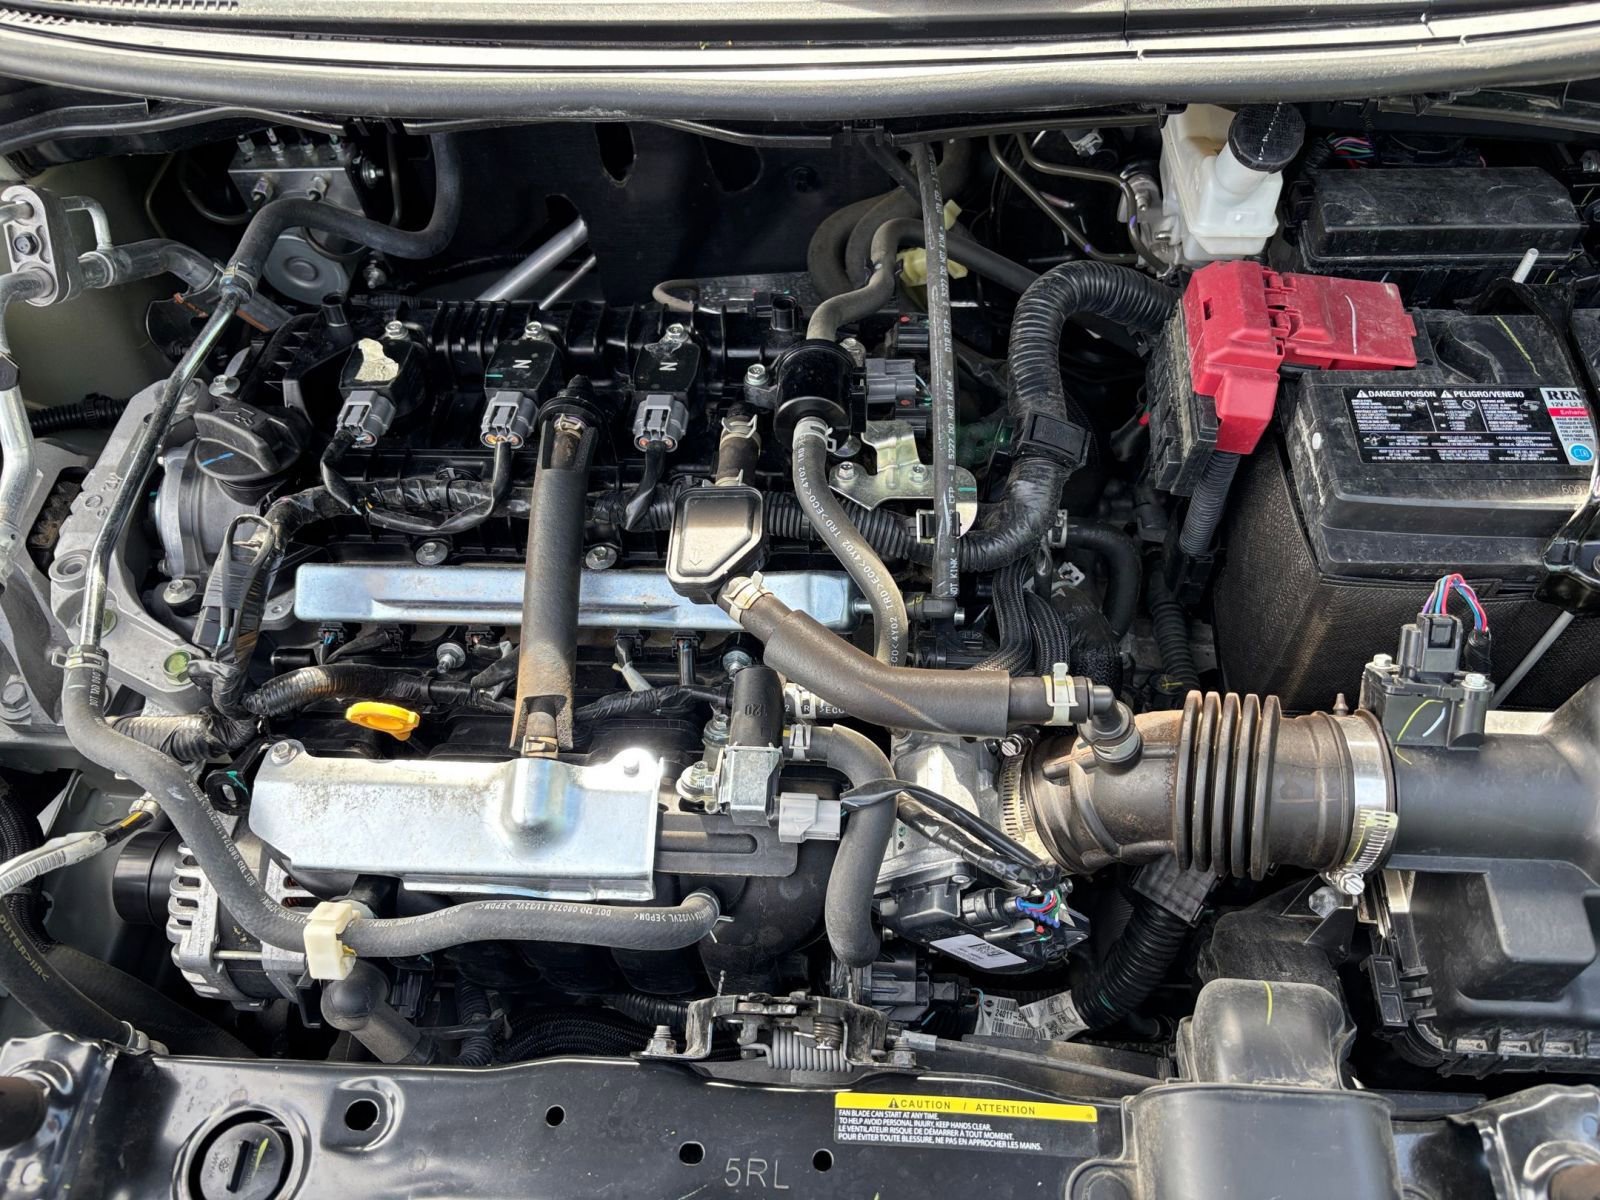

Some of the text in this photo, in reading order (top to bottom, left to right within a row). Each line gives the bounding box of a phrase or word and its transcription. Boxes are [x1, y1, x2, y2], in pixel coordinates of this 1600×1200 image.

[1368, 390, 1525, 398] DANGER/POISON PELIGRO/VENENO
[798, 466, 809, 488] 4Y02
[825, 519, 842, 538] TRD
[842, 540, 860, 561] 4Y02
[950, 558, 958, 579] KINK
[880, 590, 894, 610] TRD
[890, 617, 898, 642] 4Y02
[596, 909, 612, 917] DOT
[900, 1099, 951, 1110] CAUTION
[975, 1103, 1036, 1115] ATTENTION
[846, 1125, 888, 1133] VENTILATEUR
[889, 1127, 913, 1135] RISQUE
[914, 1127, 923, 1135] DE
[923, 1127, 959, 1136] DÉMARRER
[965, 1130, 982, 1138] TOUT
[983, 1131, 1014, 1140] MOMENT.
[848, 1117, 863, 1125] HELP
[883, 1118, 913, 1126] PERSONAL
[935, 1120, 950, 1128] KEEP
[950, 1121, 972, 1130] HANDS
[972, 1123, 992, 1131] CLEAR.
[858, 1132, 879, 1141] ÉVITER
[880, 1134, 900, 1142] TOUTE
[901, 1135, 935, 1144] BLESSURE,
[945, 1137, 957, 1145] PAS
[968, 1139, 1006, 1148] APPROCHER
[1007, 1141, 1018, 1149] LES
[1019, 1142, 1042, 1150] MAINS.
[724, 1157, 790, 1189] 5RL
